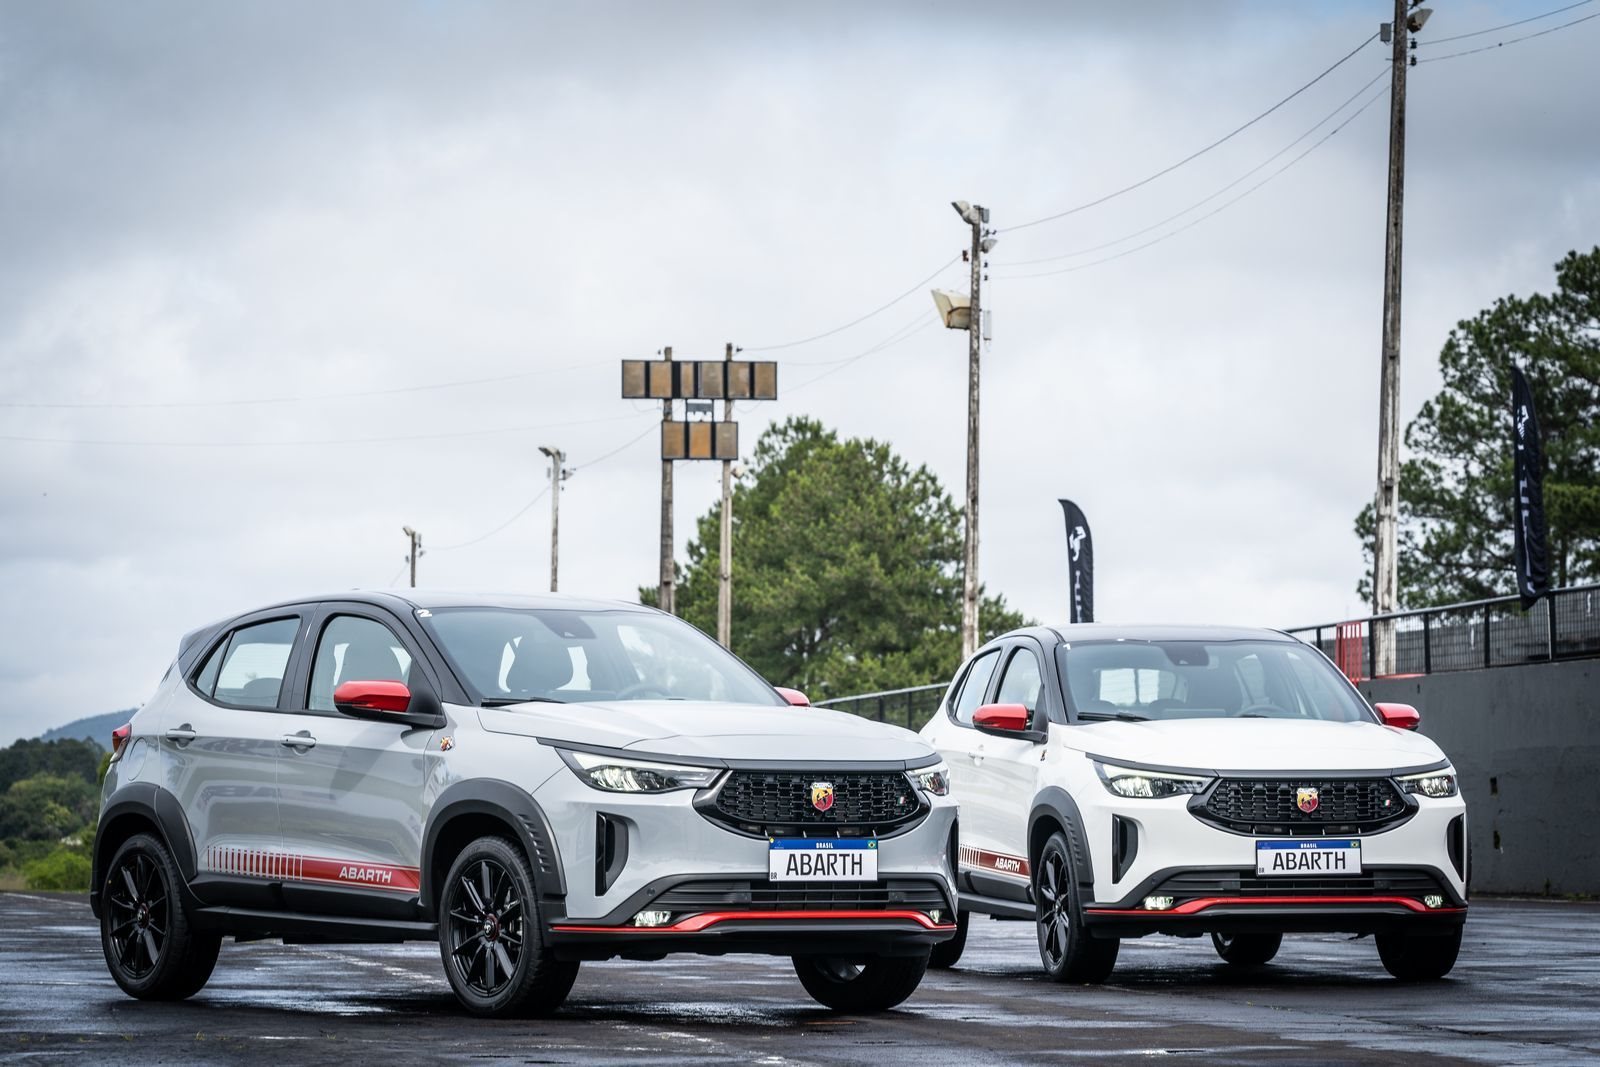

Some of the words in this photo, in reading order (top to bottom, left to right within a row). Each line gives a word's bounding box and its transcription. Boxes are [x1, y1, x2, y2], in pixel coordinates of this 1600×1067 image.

[786, 853, 862, 875] ABARTH
[995, 857, 1020, 872] ABARTH
[1273, 852, 1346, 870] ABARTH
[339, 867, 392, 882] ABARTH
